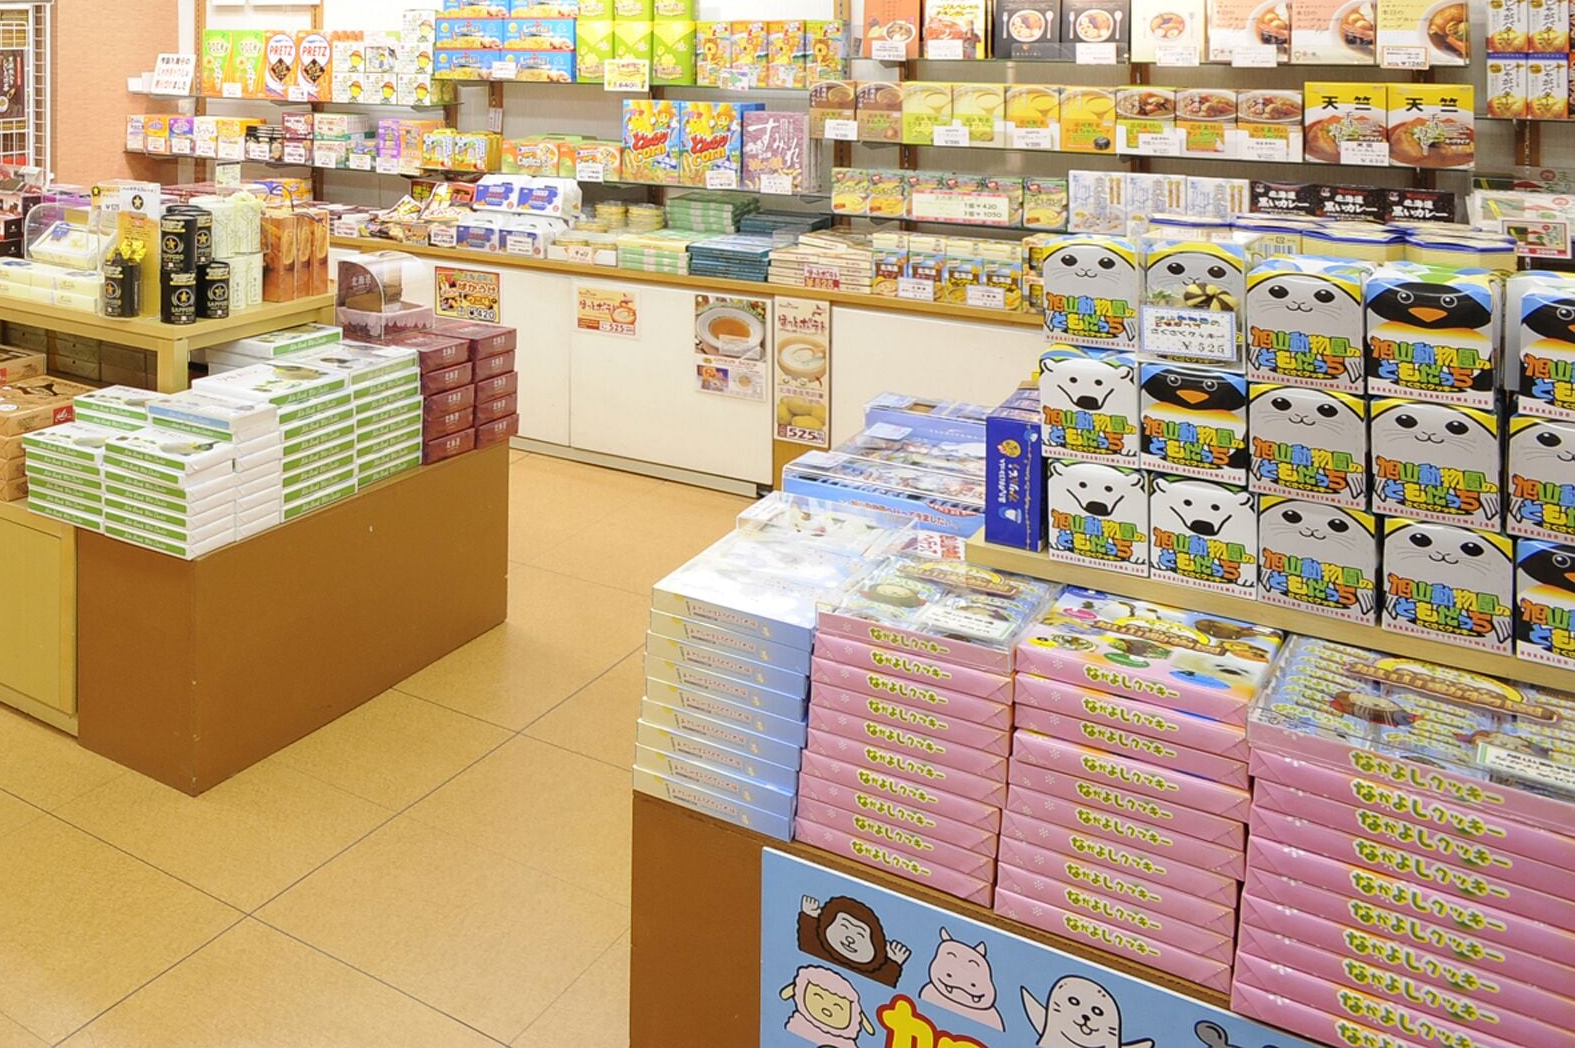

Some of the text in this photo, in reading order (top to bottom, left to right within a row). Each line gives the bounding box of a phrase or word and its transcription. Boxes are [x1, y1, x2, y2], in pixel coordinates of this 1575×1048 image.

[270, 46, 293, 57] PRETZ
[303, 46, 328, 57] PRETZ
[1323, 201, 1378, 213] 黒いカレー
[1391, 206, 1449, 218] 黒いカレー
[1046, 292, 1135, 318] 旭山動物園の
[1250, 326, 1361, 357] 旭山動物園の
[1371, 336, 1491, 370] 旭山動物園の
[1043, 405, 1136, 434] 旭山動物園の
[1144, 415, 1245, 449] 旭山動物園の
[1253, 436, 1364, 473] 旭山動物園の
[1376, 455, 1499, 494] 旭山動物園の
[1051, 509, 1146, 542] 旭山動物園の
[1153, 527, 1255, 563] 旭山動物園の
[1263, 548, 1375, 589] 旭山動物園の
[1388, 572, 1511, 616] 旭山動物園の
[869, 627, 949, 654] なかよしクッキー
[873, 651, 951, 679] なかよしクッキー
[1085, 665, 1178, 699] なかよしクッキー
[868, 674, 946, 704] なかよしクッキー
[869, 699, 947, 729] なかよしクッキー
[1084, 698, 1178, 732] なかよしクッキー
[866, 722, 944, 753] なかよしクッキー
[1082, 723, 1175, 757] なかよしクッキー
[859, 770, 937, 802] なかよしクッキー
[1083, 756, 1178, 792] なかよしクッキー
[1350, 751, 1503, 804] なかよしクッキー
[1077, 782, 1172, 819] なかよしクッキー
[1355, 781, 1506, 838] なかよしクッキー
[855, 817, 932, 849] なかよしクッキー
[1358, 810, 1512, 868] なかよしクッキー
[852, 840, 930, 875] なかよしクッキー
[1072, 836, 1165, 874] なかよしクッキー
[1357, 840, 1510, 898] なかよしクッキー
[1067, 863, 1161, 902] なかよしクッキー
[1065, 916, 1159, 956] なかよしクッキー
[1352, 902, 1505, 962] なかよしクッキー
[1347, 931, 1499, 993] なかよしクッキー
[1340, 960, 1499, 1024] なかよしクッキー
